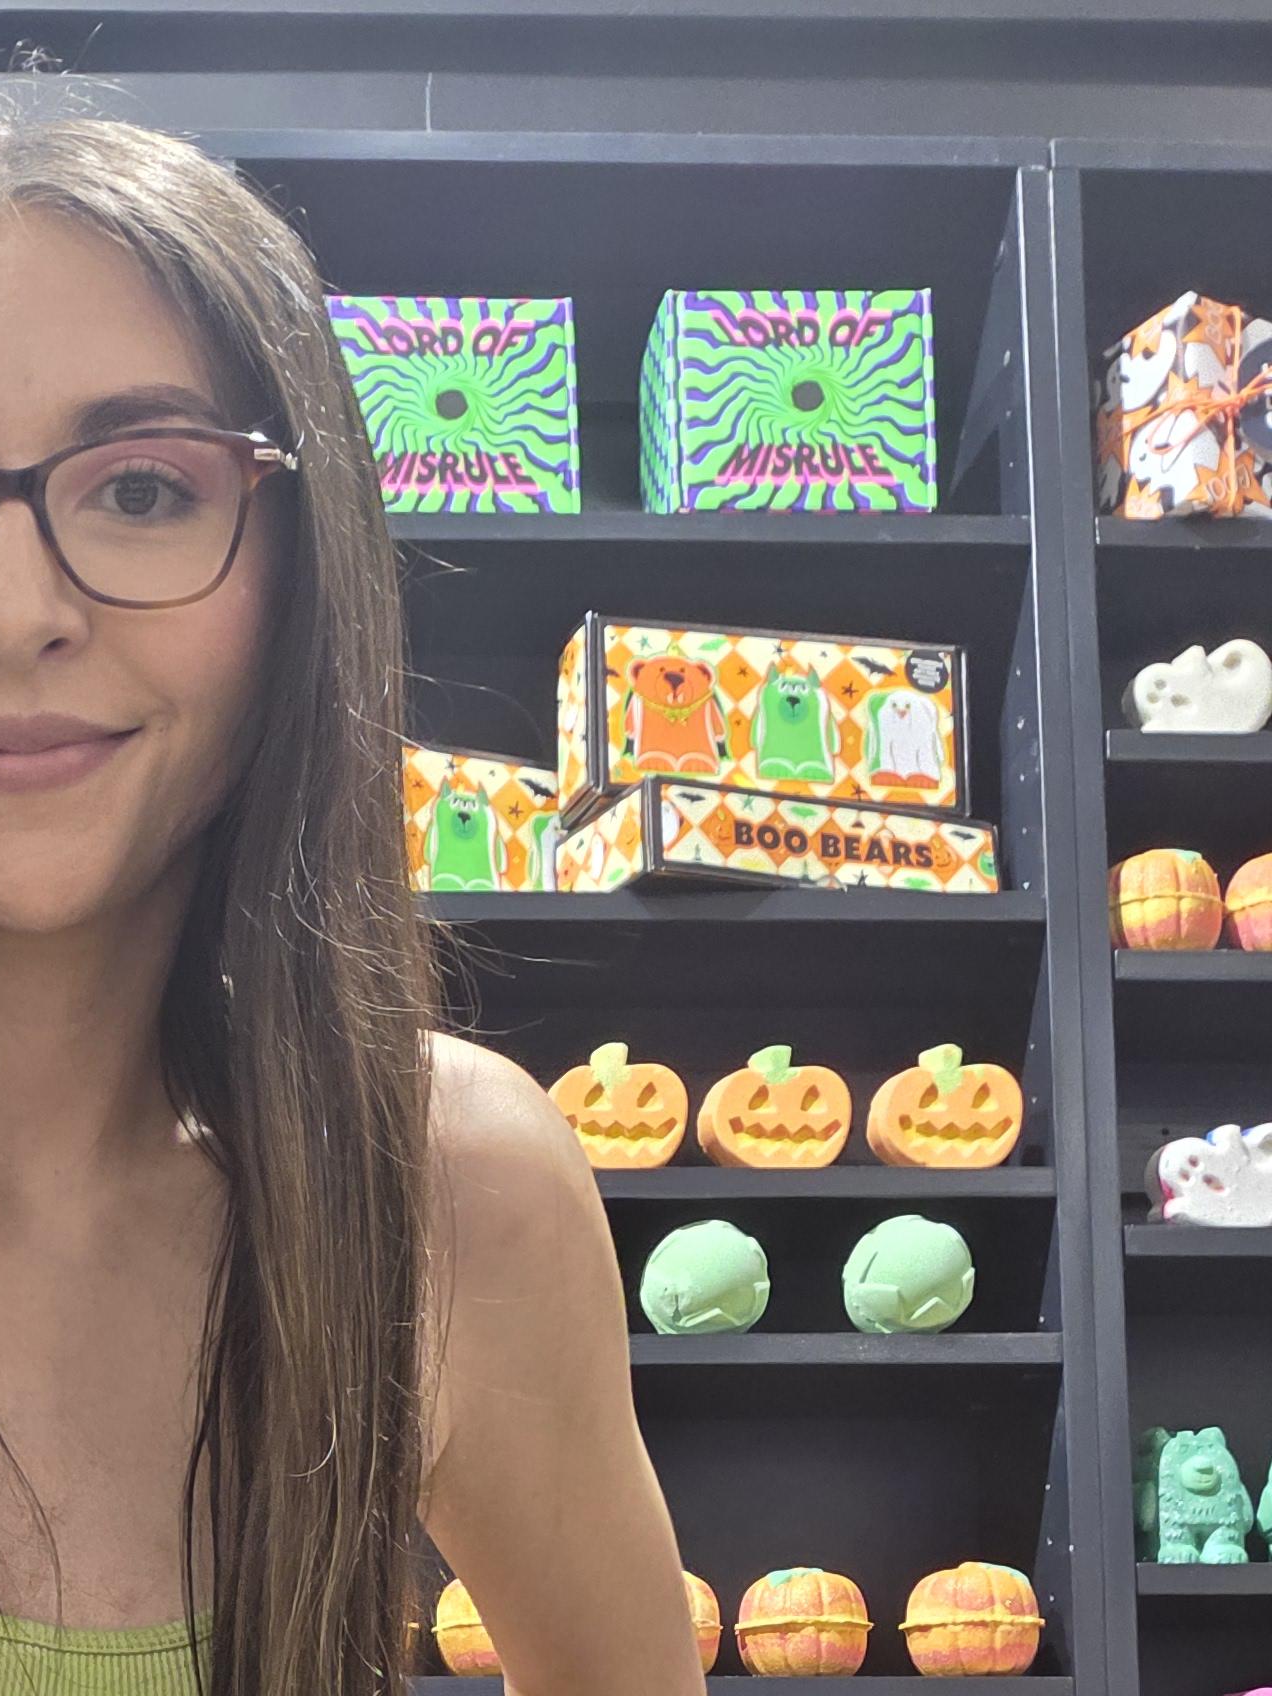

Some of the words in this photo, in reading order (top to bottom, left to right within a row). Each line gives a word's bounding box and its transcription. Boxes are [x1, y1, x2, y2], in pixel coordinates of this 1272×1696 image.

[354, 317, 463, 359] LORD
[473, 317, 535, 356] OF
[710, 309, 819, 350] LORD
[829, 309, 892, 347] OF
[714, 444, 896, 485] MISRULE
[734, 819, 808, 855] BOO
[821, 833, 934, 868] BEARS
